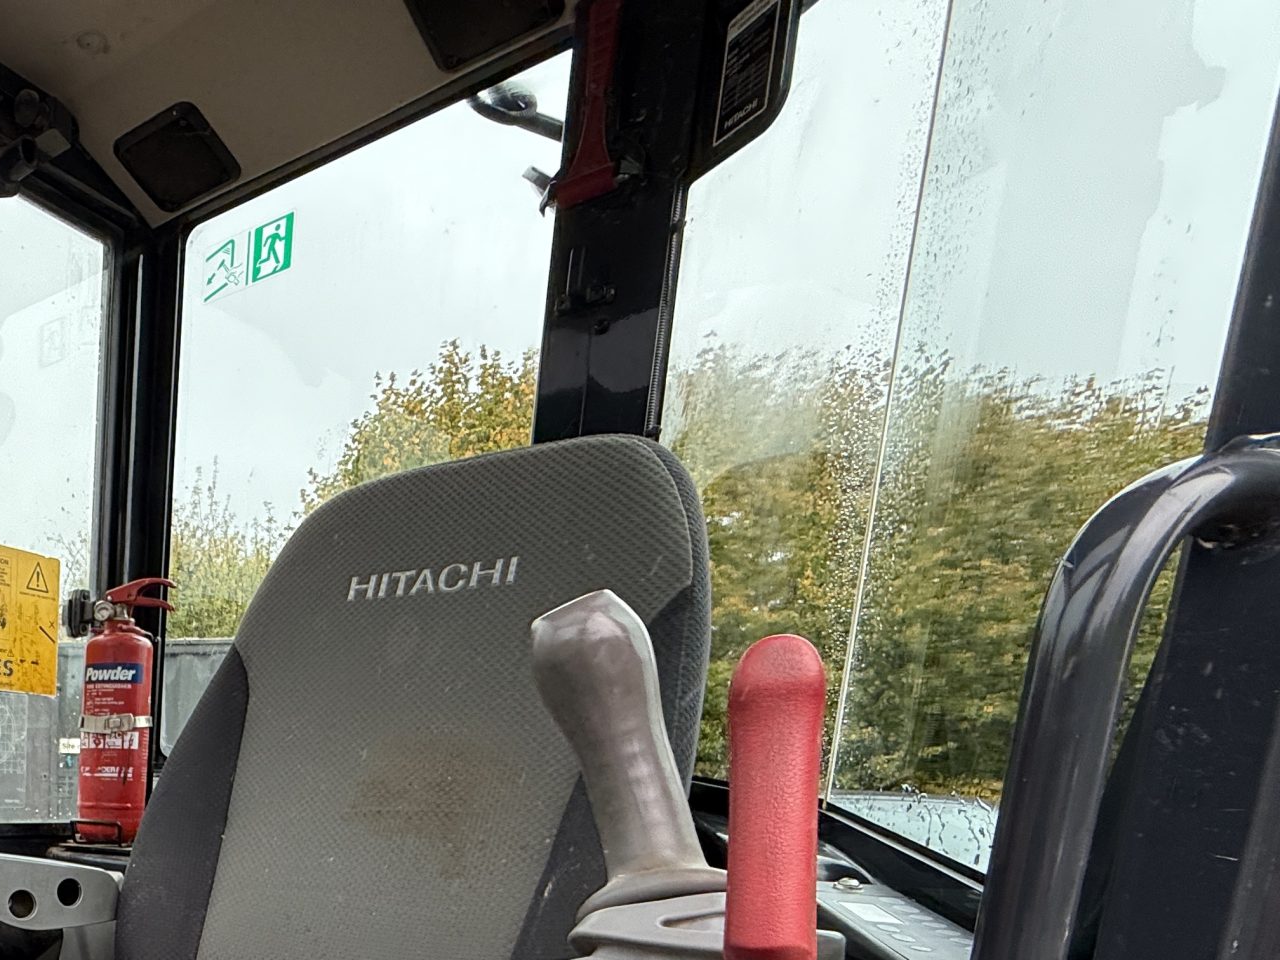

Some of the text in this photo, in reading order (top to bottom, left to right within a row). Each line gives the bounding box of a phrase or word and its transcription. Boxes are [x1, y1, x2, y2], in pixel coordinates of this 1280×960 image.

[724, 98, 758, 129] HITACHI
[347, 555, 519, 601] HITACHI
[86, 666, 136, 681] Powder
